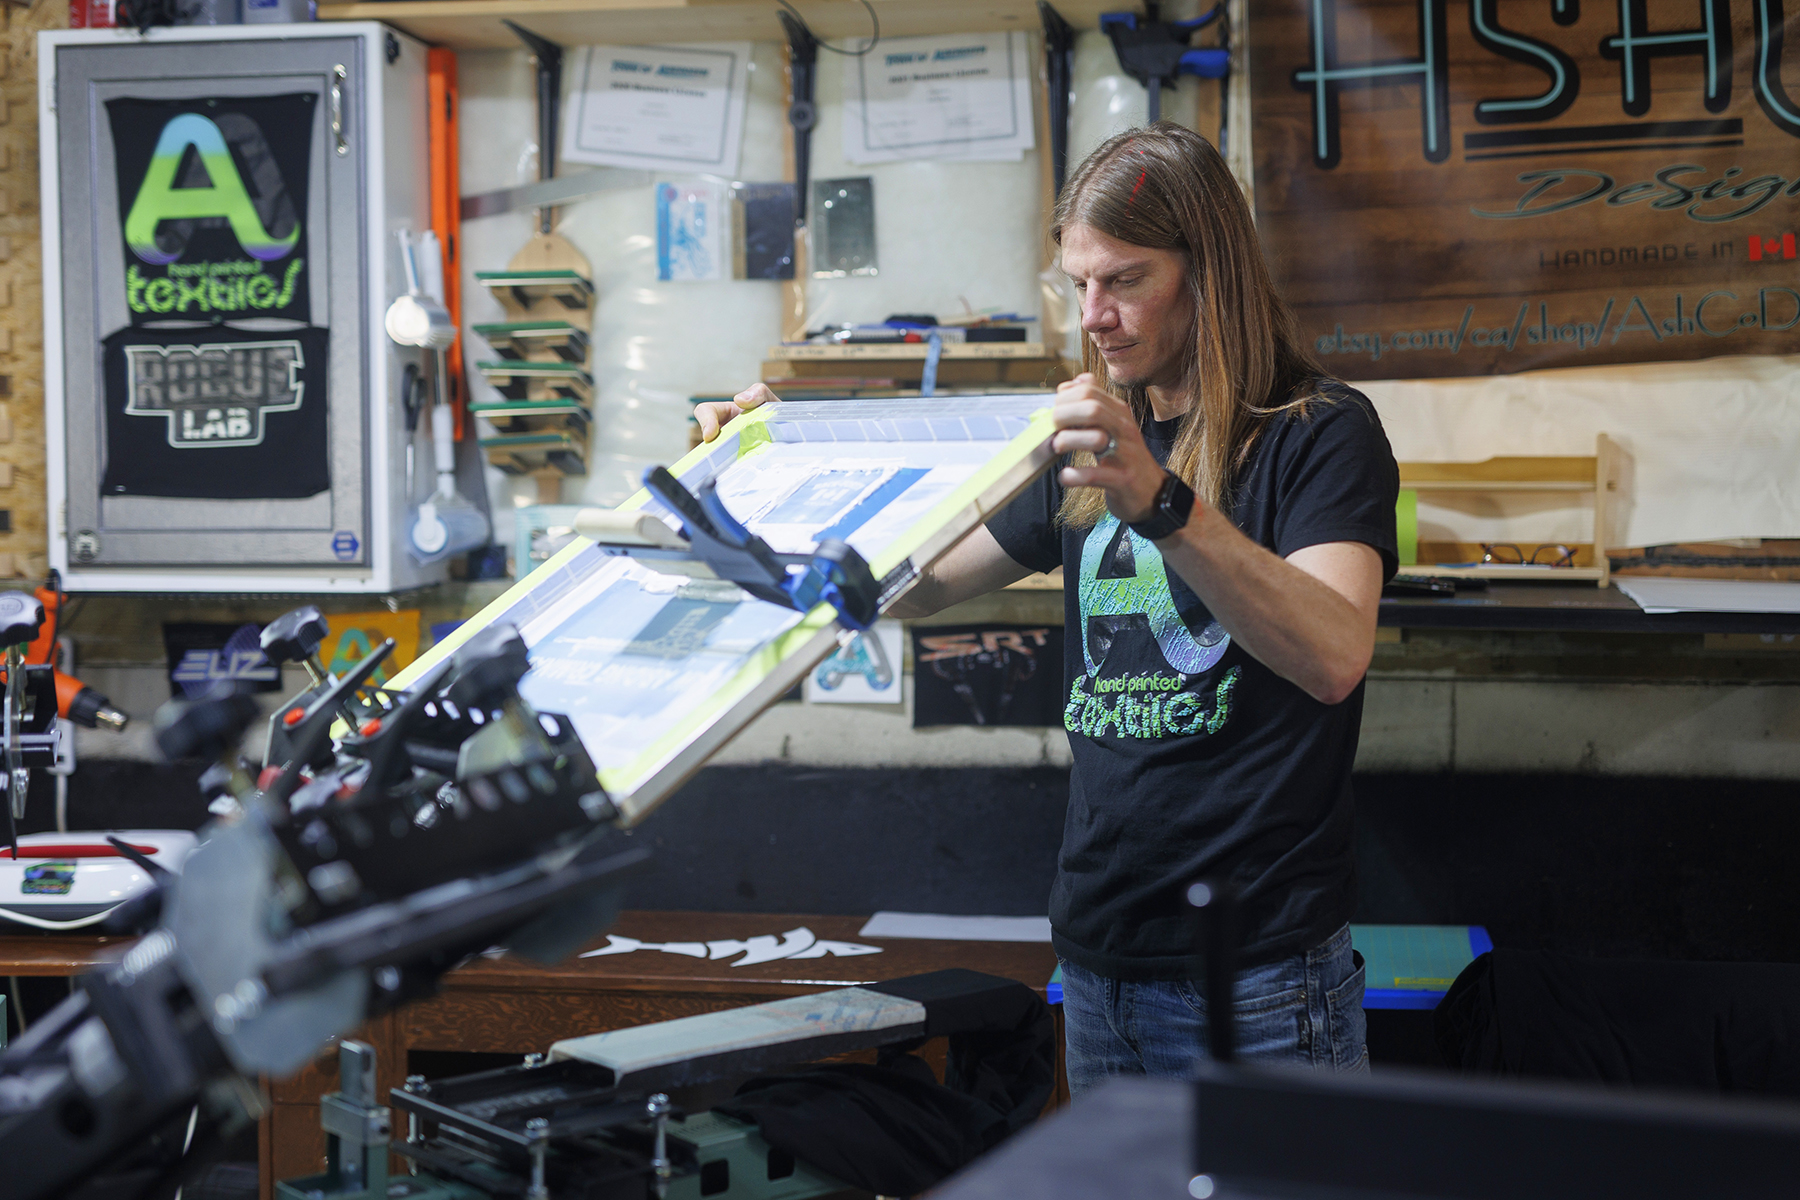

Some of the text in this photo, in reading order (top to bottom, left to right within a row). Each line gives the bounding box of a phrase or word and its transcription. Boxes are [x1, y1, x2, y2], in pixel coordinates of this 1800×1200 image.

[1539, 240, 1733, 269] HANDMADE IN
[183, 407, 251, 439] LAB
[919, 628, 1049, 662] SRT
[1094, 671, 1183, 695] hand printed
